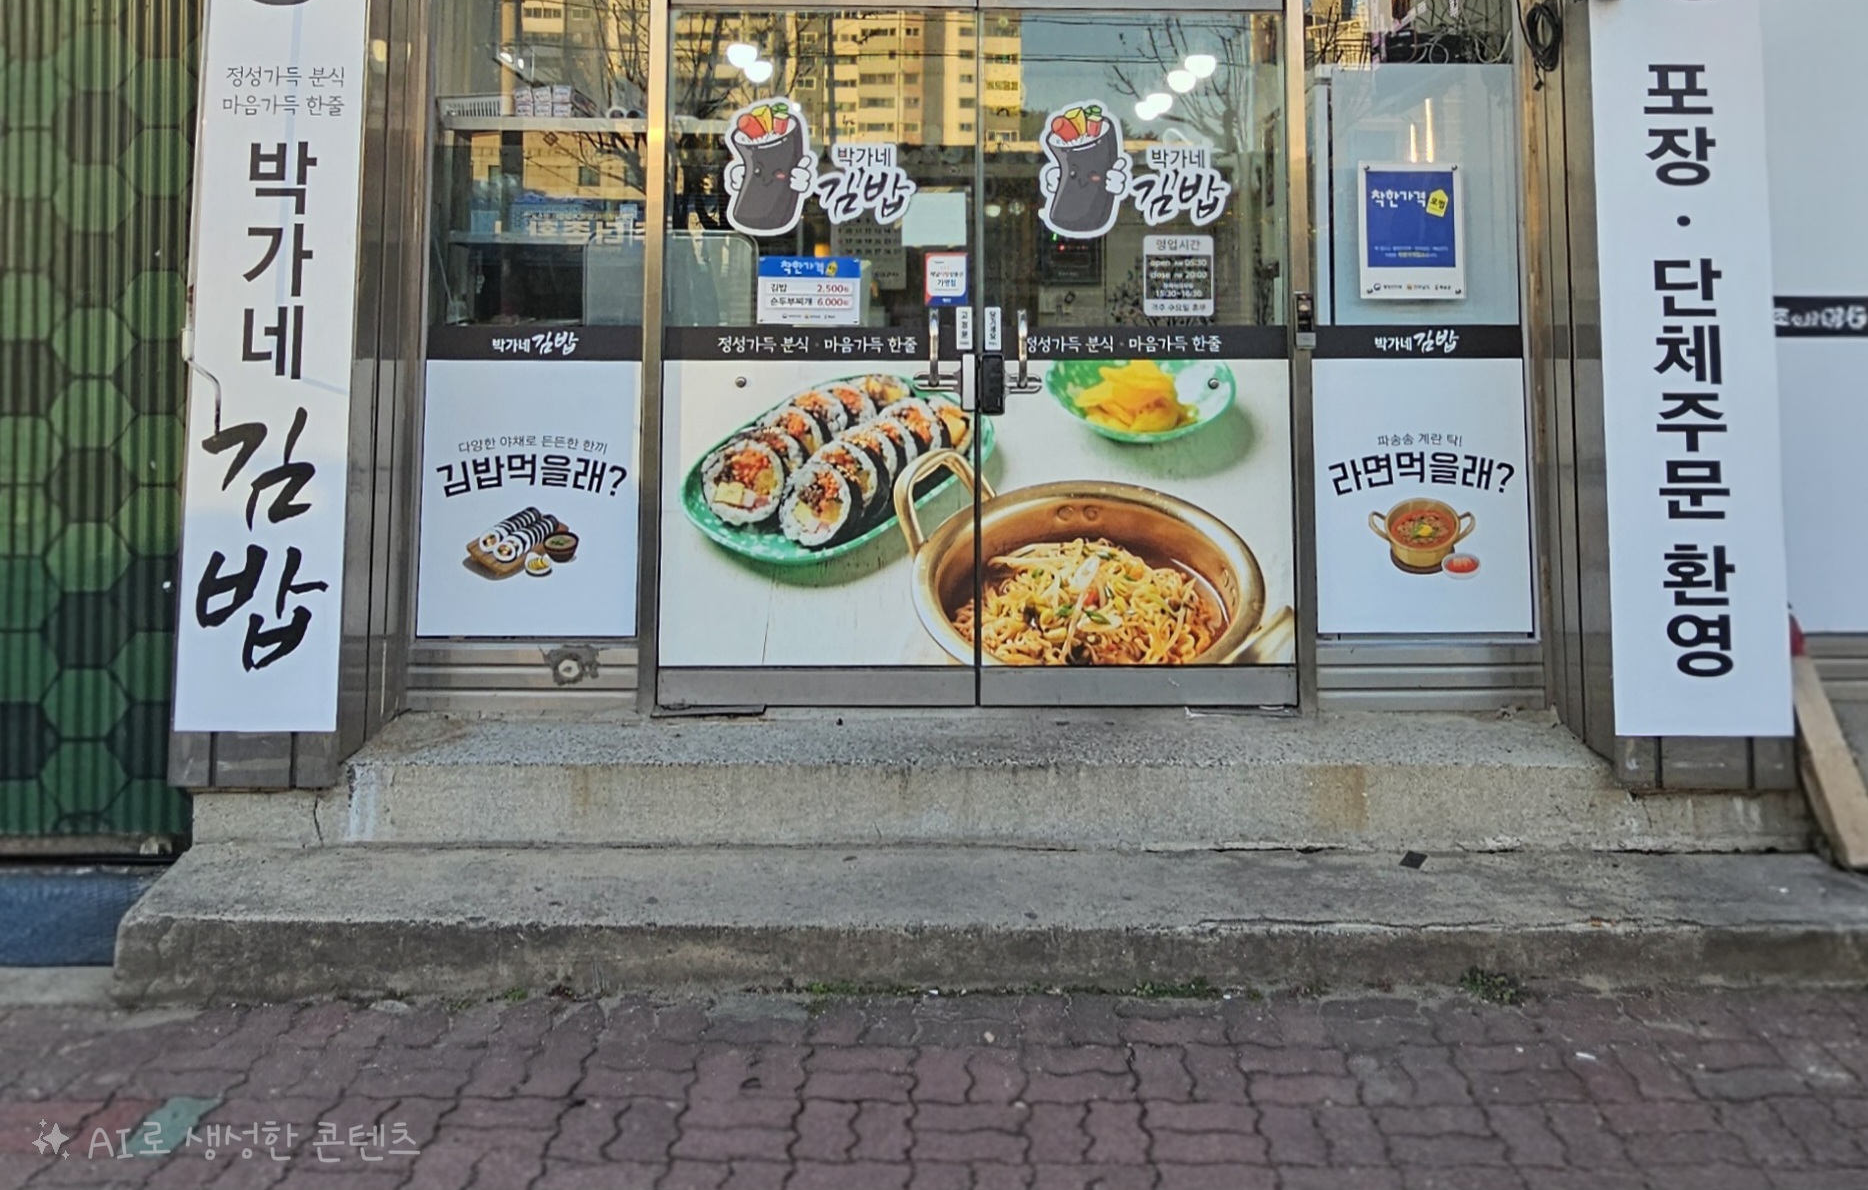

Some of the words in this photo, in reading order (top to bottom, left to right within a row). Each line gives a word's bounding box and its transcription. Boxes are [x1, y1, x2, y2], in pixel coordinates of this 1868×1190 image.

[226, 66, 302, 88] 정성가득
[308, 66, 346, 88] 분식
[222, 95, 300, 116] 마음가득
[306, 94, 345, 117] 한줄
[1643, 63, 1717, 187] 포장
[837, 147, 891, 167] 박가네
[1150, 149, 1205, 169] 박가네
[818, 167, 910, 219] 김밥
[1134, 167, 1226, 219] 김밥
[1371, 189, 1426, 208] 착한가격
[1156, 239, 1200, 250] 영업시간
[242, 140, 318, 380] 박가네
[781, 260, 825, 275] 착한가격
[492, 337, 531, 353] 박가네
[532, 331, 579, 355] 김밥
[717, 336, 777, 353] 정성가득
[780, 337, 809, 353] 분식
[824, 337, 884, 353] 마음가득
[888, 337, 918, 353] 한줄
[1085, 337, 1114, 353] 분식
[1129, 336, 1188, 353] 마음가득
[1192, 335, 1222, 352] 한줄
[1374, 336, 1412, 351] 박가네
[1413, 329, 1459, 354] 김밥
[1653, 257, 1731, 520] 단체주문
[458, 437, 496, 454] 다양한
[500, 435, 537, 447] 야채로
[541, 435, 578, 448] 든든한
[583, 439, 608, 454] 한끼
[1377, 433, 1414, 448] 파송송
[1418, 432, 1442, 447] 계란
[436, 453, 628, 498] 김밥먹을래?
[1328, 451, 1515, 496] 라면먹을래?
[195, 406, 328, 673] 김밥
[1663, 543, 1736, 678] 환영
